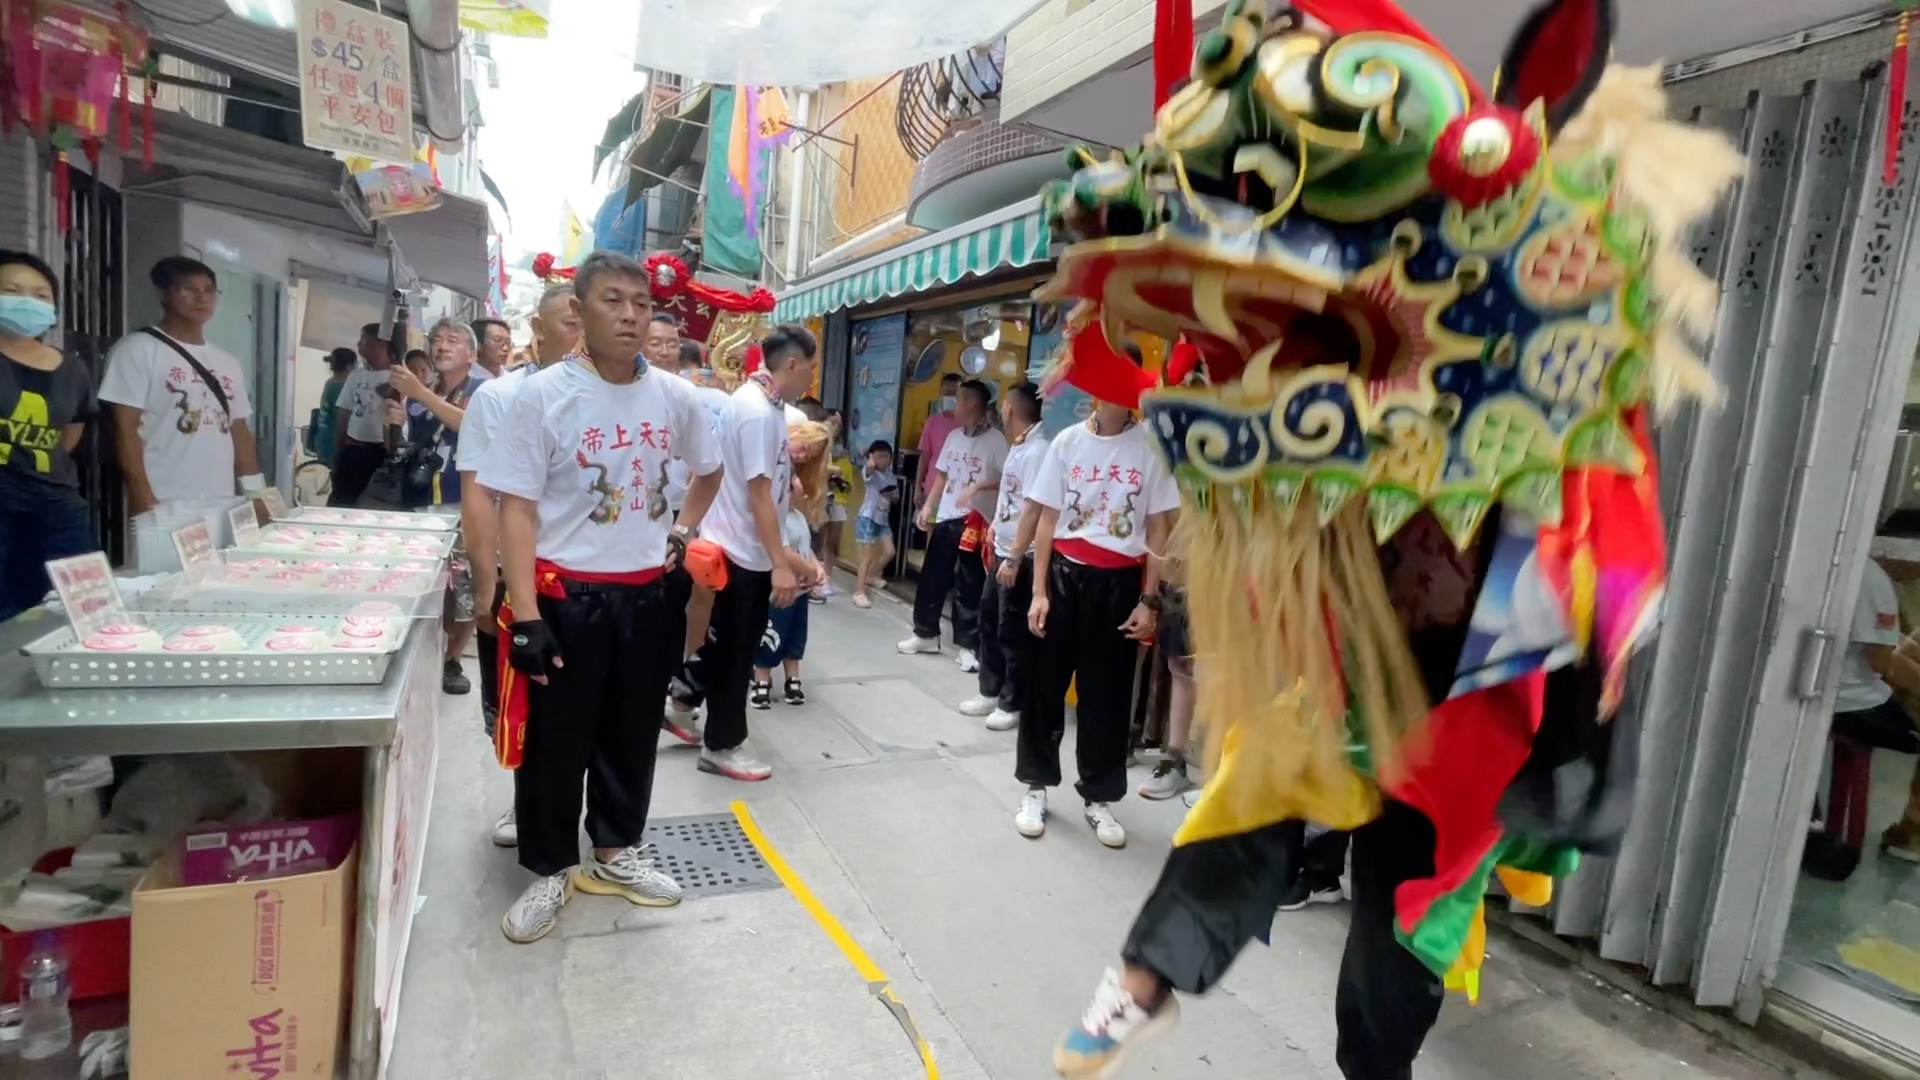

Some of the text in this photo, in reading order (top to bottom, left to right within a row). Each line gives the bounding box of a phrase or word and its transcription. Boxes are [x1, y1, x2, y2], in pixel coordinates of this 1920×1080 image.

[320, 94, 397, 135] 平安包
[630, 456, 644, 511] 太平山
